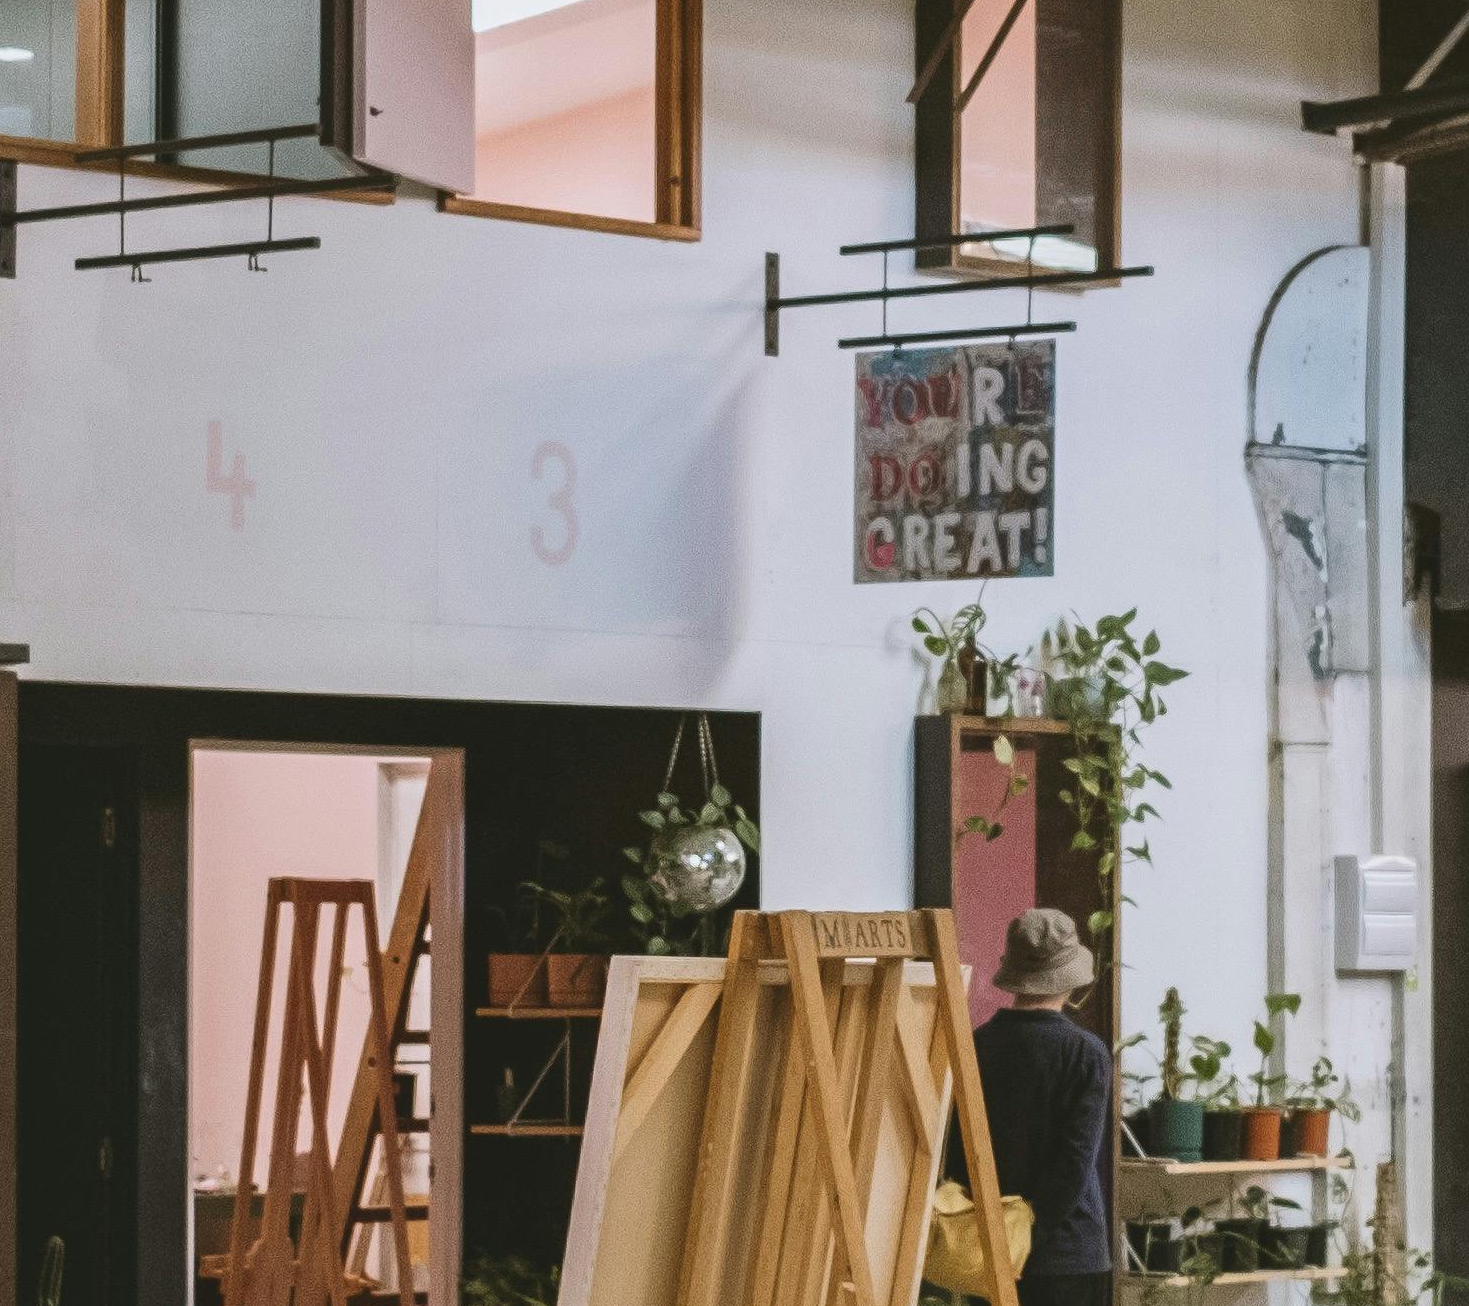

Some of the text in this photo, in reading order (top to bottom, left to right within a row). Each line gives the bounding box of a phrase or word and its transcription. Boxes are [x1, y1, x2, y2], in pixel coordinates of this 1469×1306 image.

[205, 420, 257, 534] 4
[530, 438, 579, 566] 3
[869, 439, 1049, 503] DOING
[865, 507, 1048, 574] GREAT!
